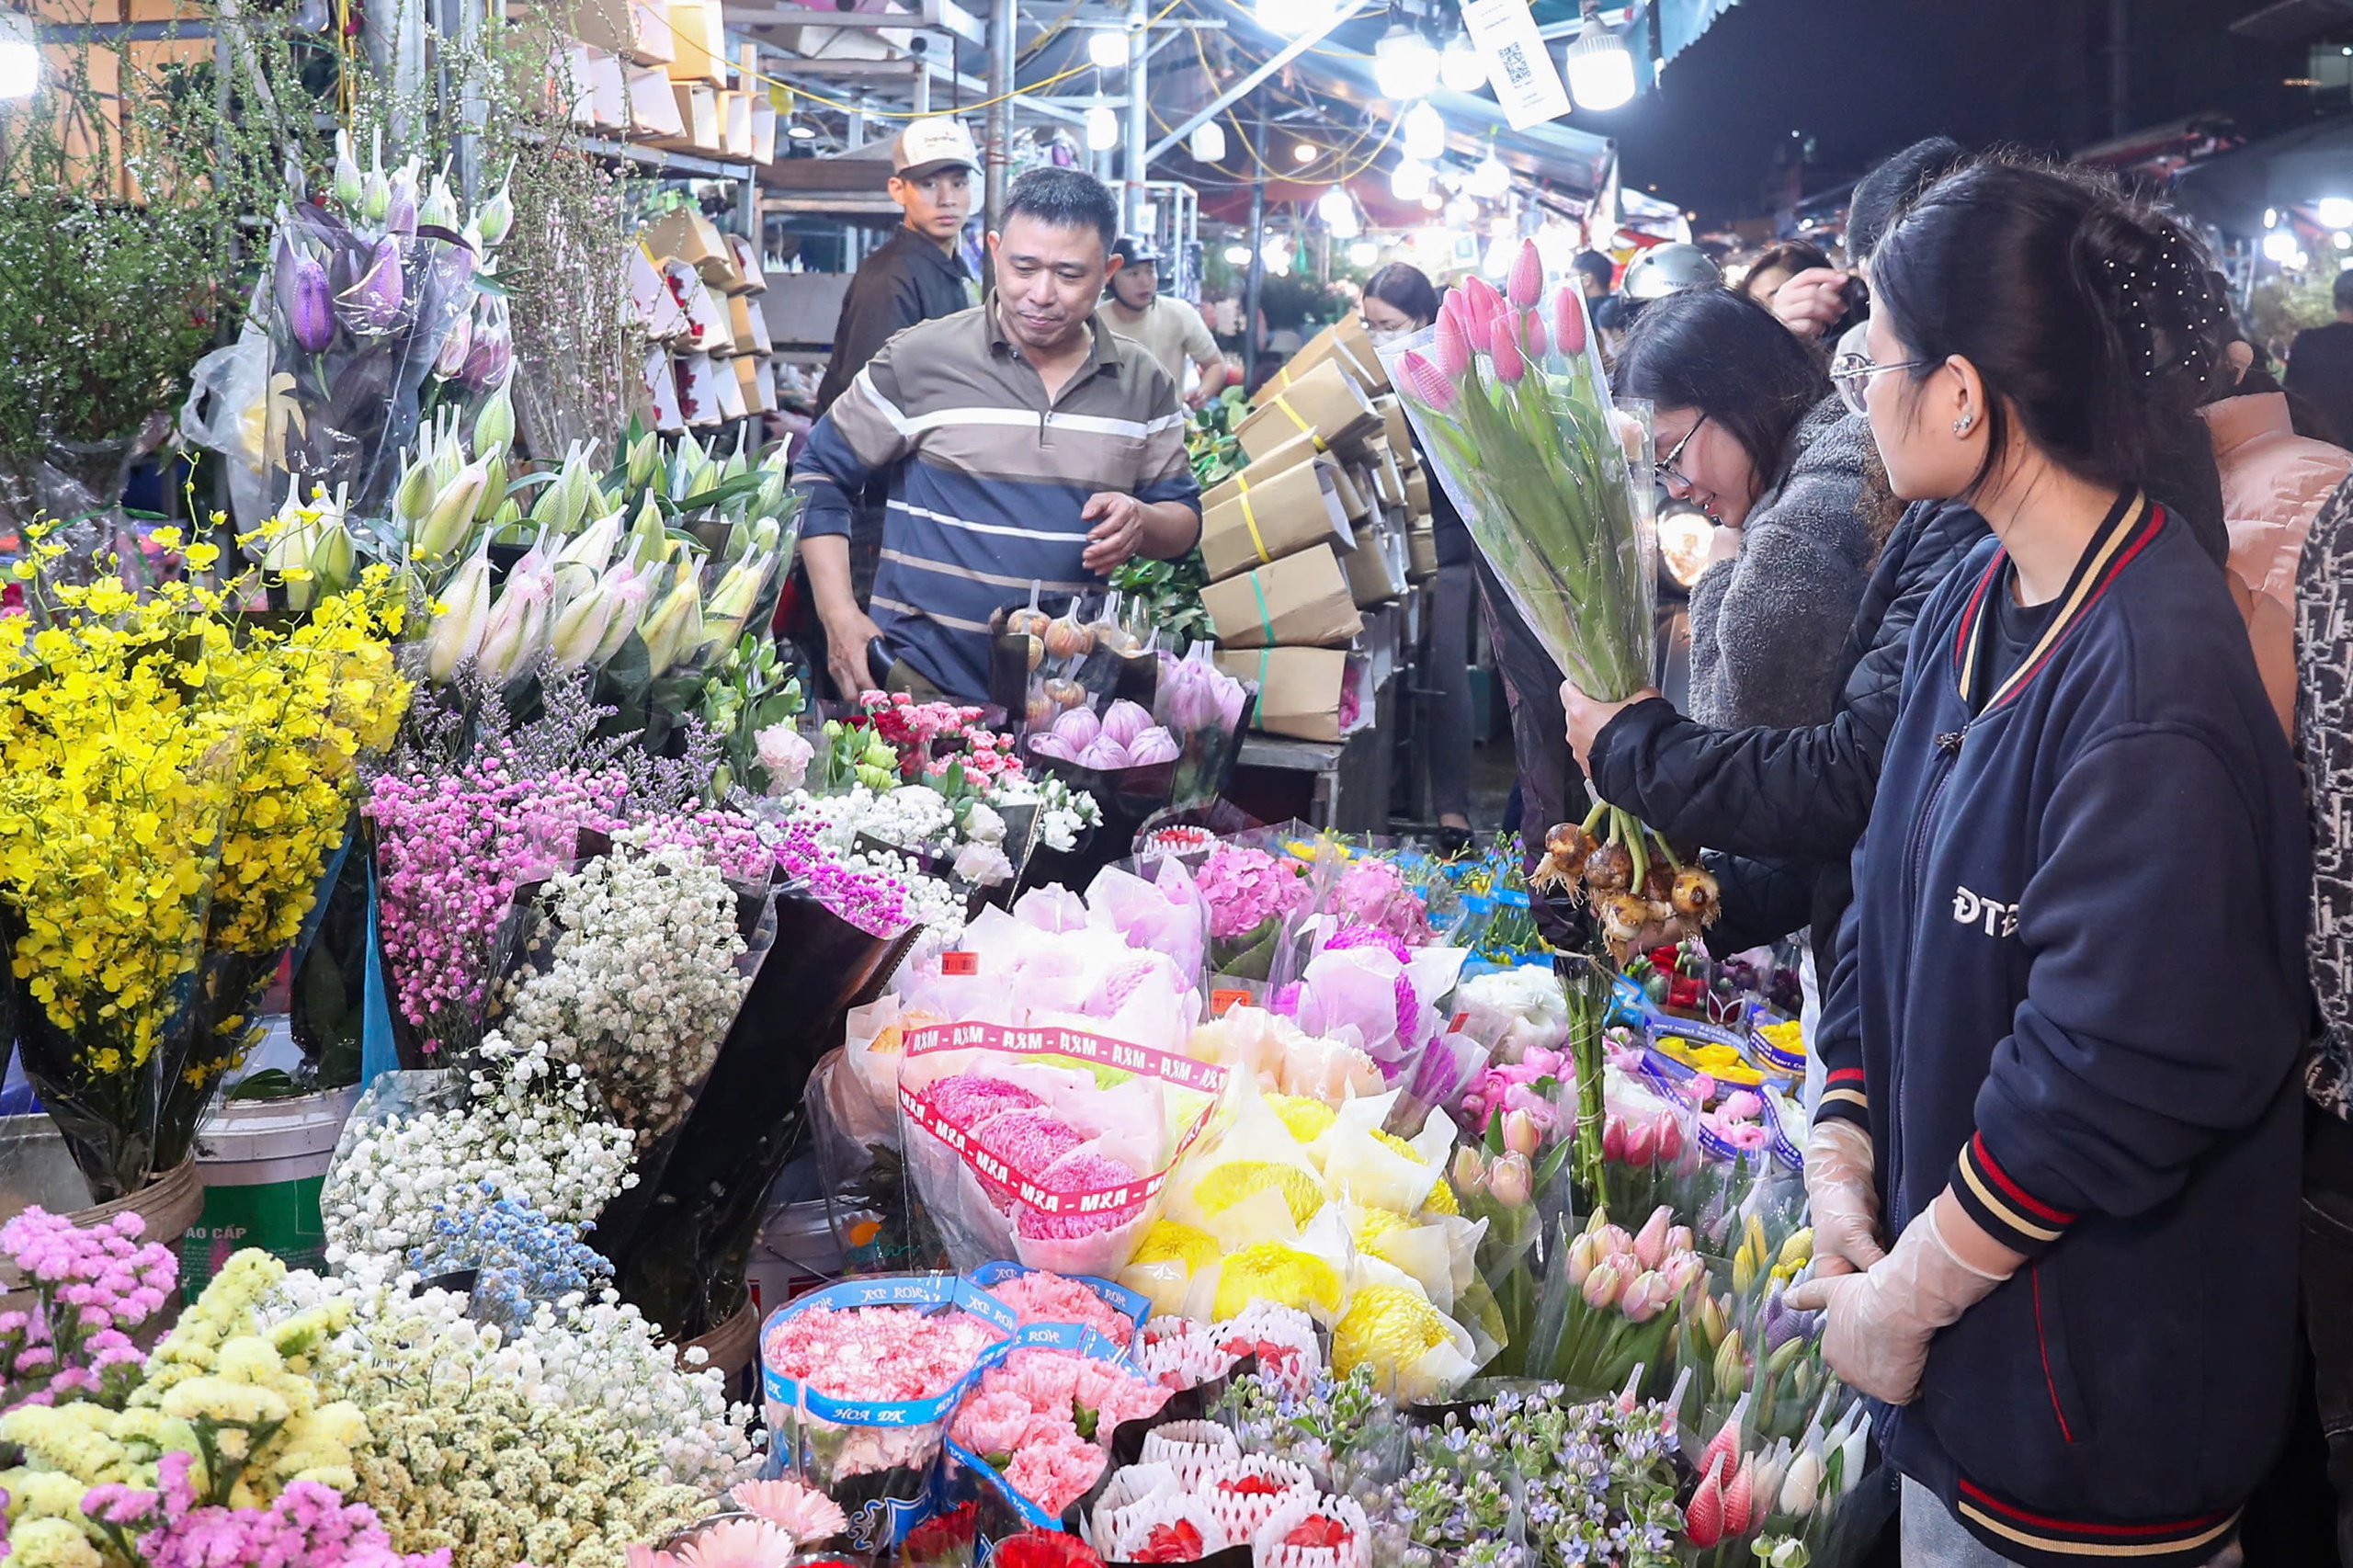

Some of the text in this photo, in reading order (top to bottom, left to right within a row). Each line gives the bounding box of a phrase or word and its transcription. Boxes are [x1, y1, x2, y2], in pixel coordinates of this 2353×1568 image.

[934, 1119, 967, 1150] M&A
[975, 1152, 1010, 1186] M&A
[1019, 1182, 1059, 1212] M&A
[1079, 1187, 1129, 1212] M&A
[185, 1227, 207, 1240] AO
[832, 1408, 906, 1424] HOA DK
